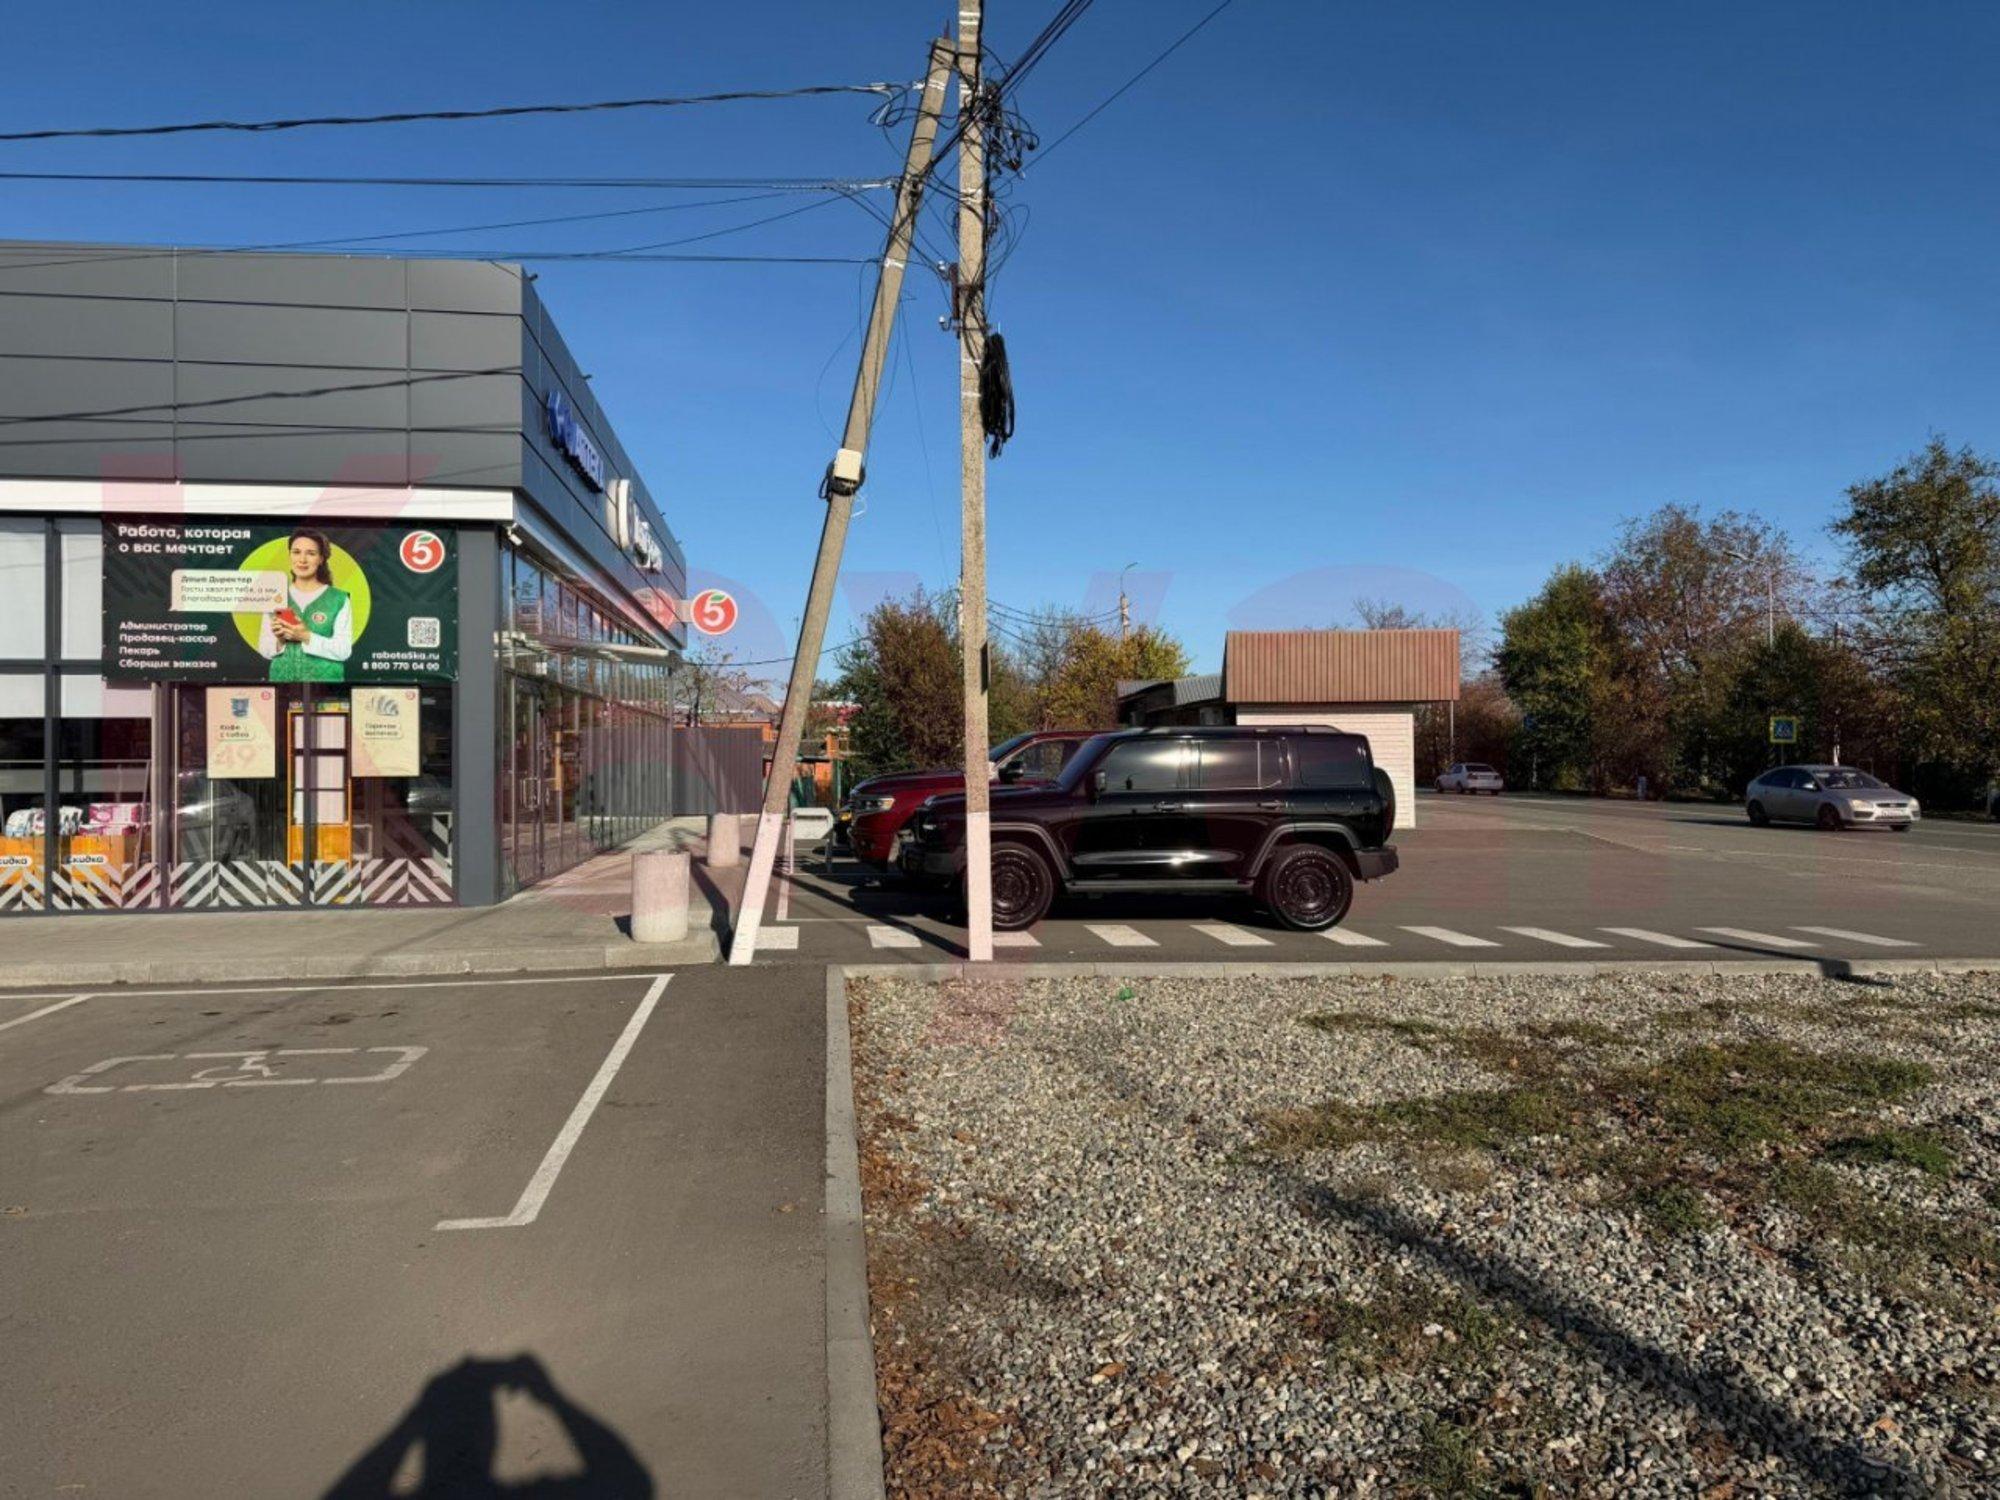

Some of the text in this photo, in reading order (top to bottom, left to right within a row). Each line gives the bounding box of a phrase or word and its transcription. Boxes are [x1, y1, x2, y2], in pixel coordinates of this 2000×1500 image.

[118, 525, 251, 541] Работа, которая
[119, 543, 233, 555] о вас мечтает
[703, 594, 727, 627] 5
[119, 621, 208, 632] Администратор
[119, 633, 218, 645] Продавец-кассир
[119, 646, 160, 657] Пекарь
[119, 658, 218, 669] Сборщик заказов
[371, 662, 391, 671] 800
[393, 662, 410, 671] 770
[412, 662, 424, 671] 04
[426, 662, 440, 671] 00
